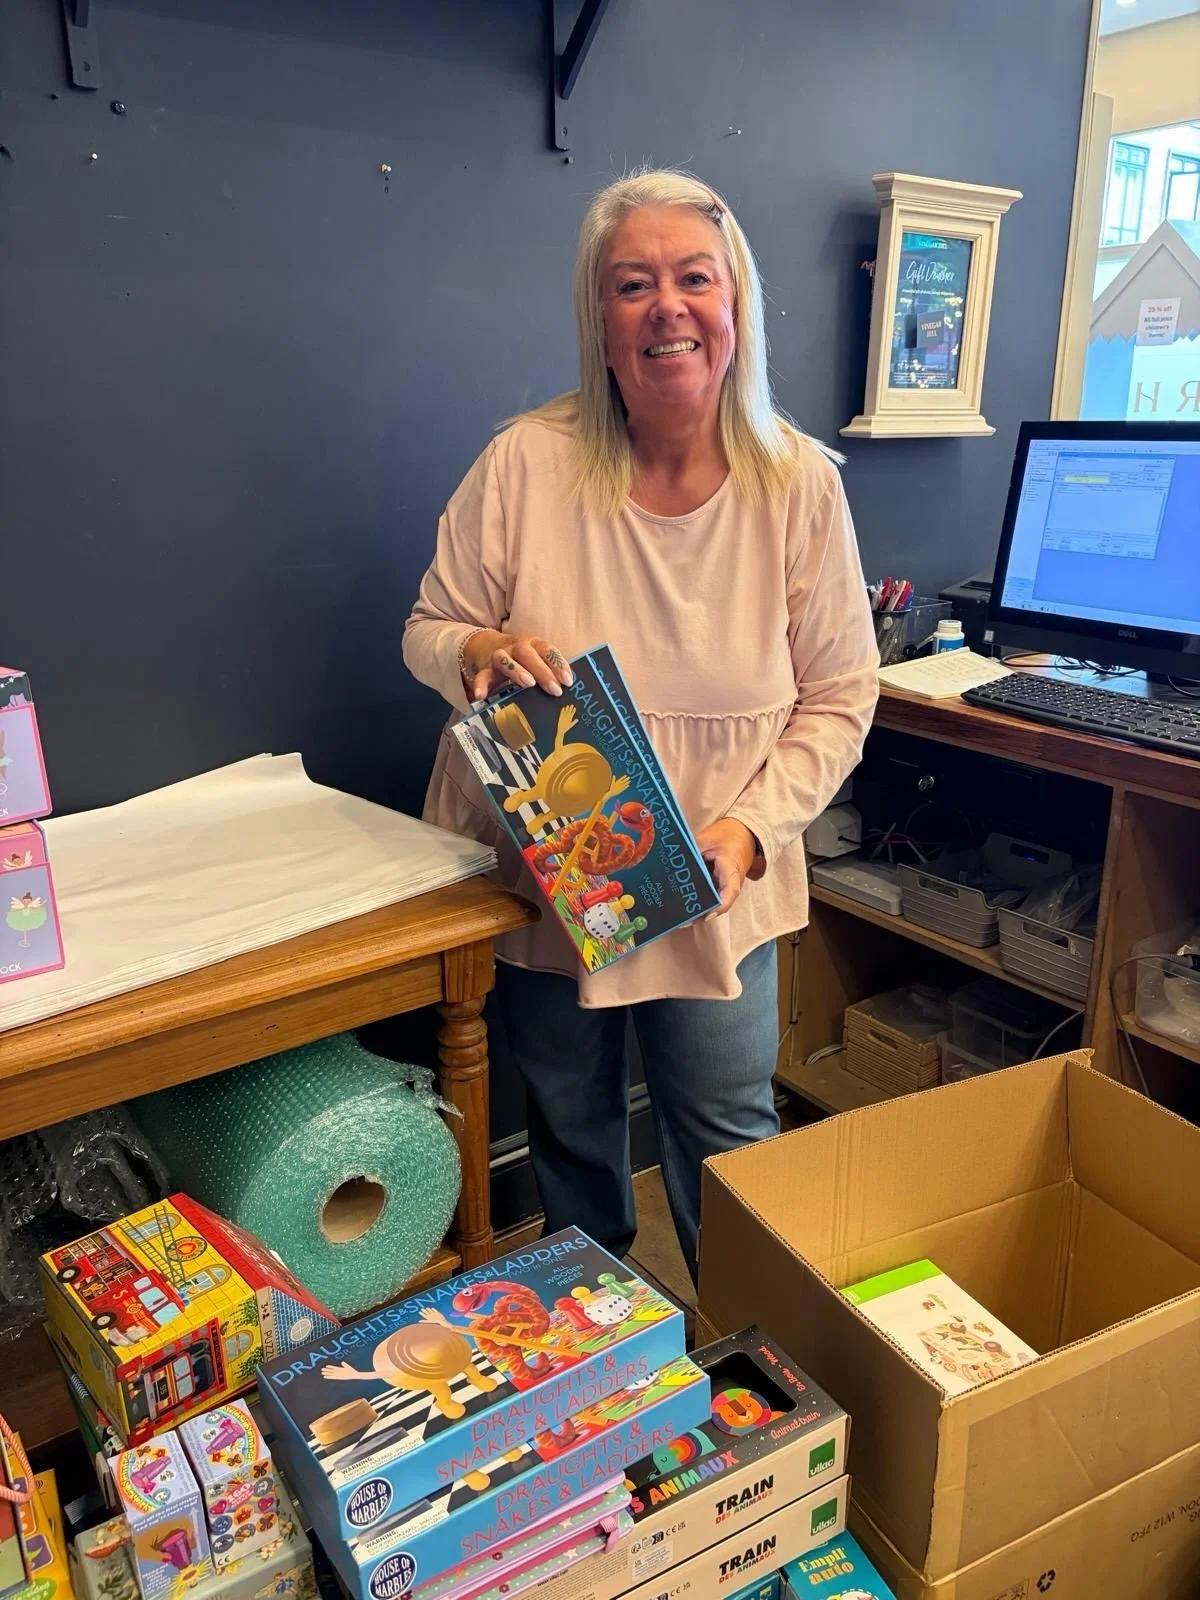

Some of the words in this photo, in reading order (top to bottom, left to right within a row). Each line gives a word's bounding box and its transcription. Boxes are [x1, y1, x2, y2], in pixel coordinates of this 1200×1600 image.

[906, 260, 924, 284] Gift
[925, 261, 955, 284] Voucher
[921, 320, 942, 331] VINEGAR
[642, 873, 665, 909] WOODEN
[506, 1266, 531, 1279] TWO
[541, 1254, 565, 1267] ONE
[544, 1263, 585, 1285] WOODEN
[552, 1264, 569, 1274] ALL
[558, 1271, 585, 1287] PIECES
[335, 1347, 351, 1361] OR
[470, 1364, 599, 1441] DRAUGHTS
[601, 1353, 618, 1373] &
[436, 1419, 528, 1484] SNAKES
[534, 1409, 547, 1427] &
[553, 1354, 650, 1414] LADDERS
[770, 1419, 799, 1441] Animal
[797, 1410, 821, 1429] train
[495, 1432, 624, 1514] DRAUGHTS
[629, 1419, 643, 1439] &
[648, 1449, 741, 1506] ANIMAUX
[809, 1459, 835, 1477] vilac
[350, 1483, 377, 1509] HOUSE
[377, 1482, 387, 1495] OF
[461, 1490, 553, 1557] SNAKES
[558, 1477, 573, 1498] &
[579, 1419, 676, 1487] LADDERS
[715, 1474, 775, 1516] TRAIN
[351, 1493, 389, 1524] MARBLES
[714, 1512, 732, 1524] DES
[733, 1489, 775, 1515] ANIMAUX
[811, 1517, 837, 1536] vilac
[374, 1558, 400, 1584] HOUSE
[400, 1557, 411, 1568] OF
[718, 1535, 777, 1576] TRAIN
[718, 1570, 735, 1585] DES
[736, 1549, 777, 1573] ANIMAUX
[375, 1567, 412, 1598] MARBLES
[807, 1561, 855, 1585] auto
